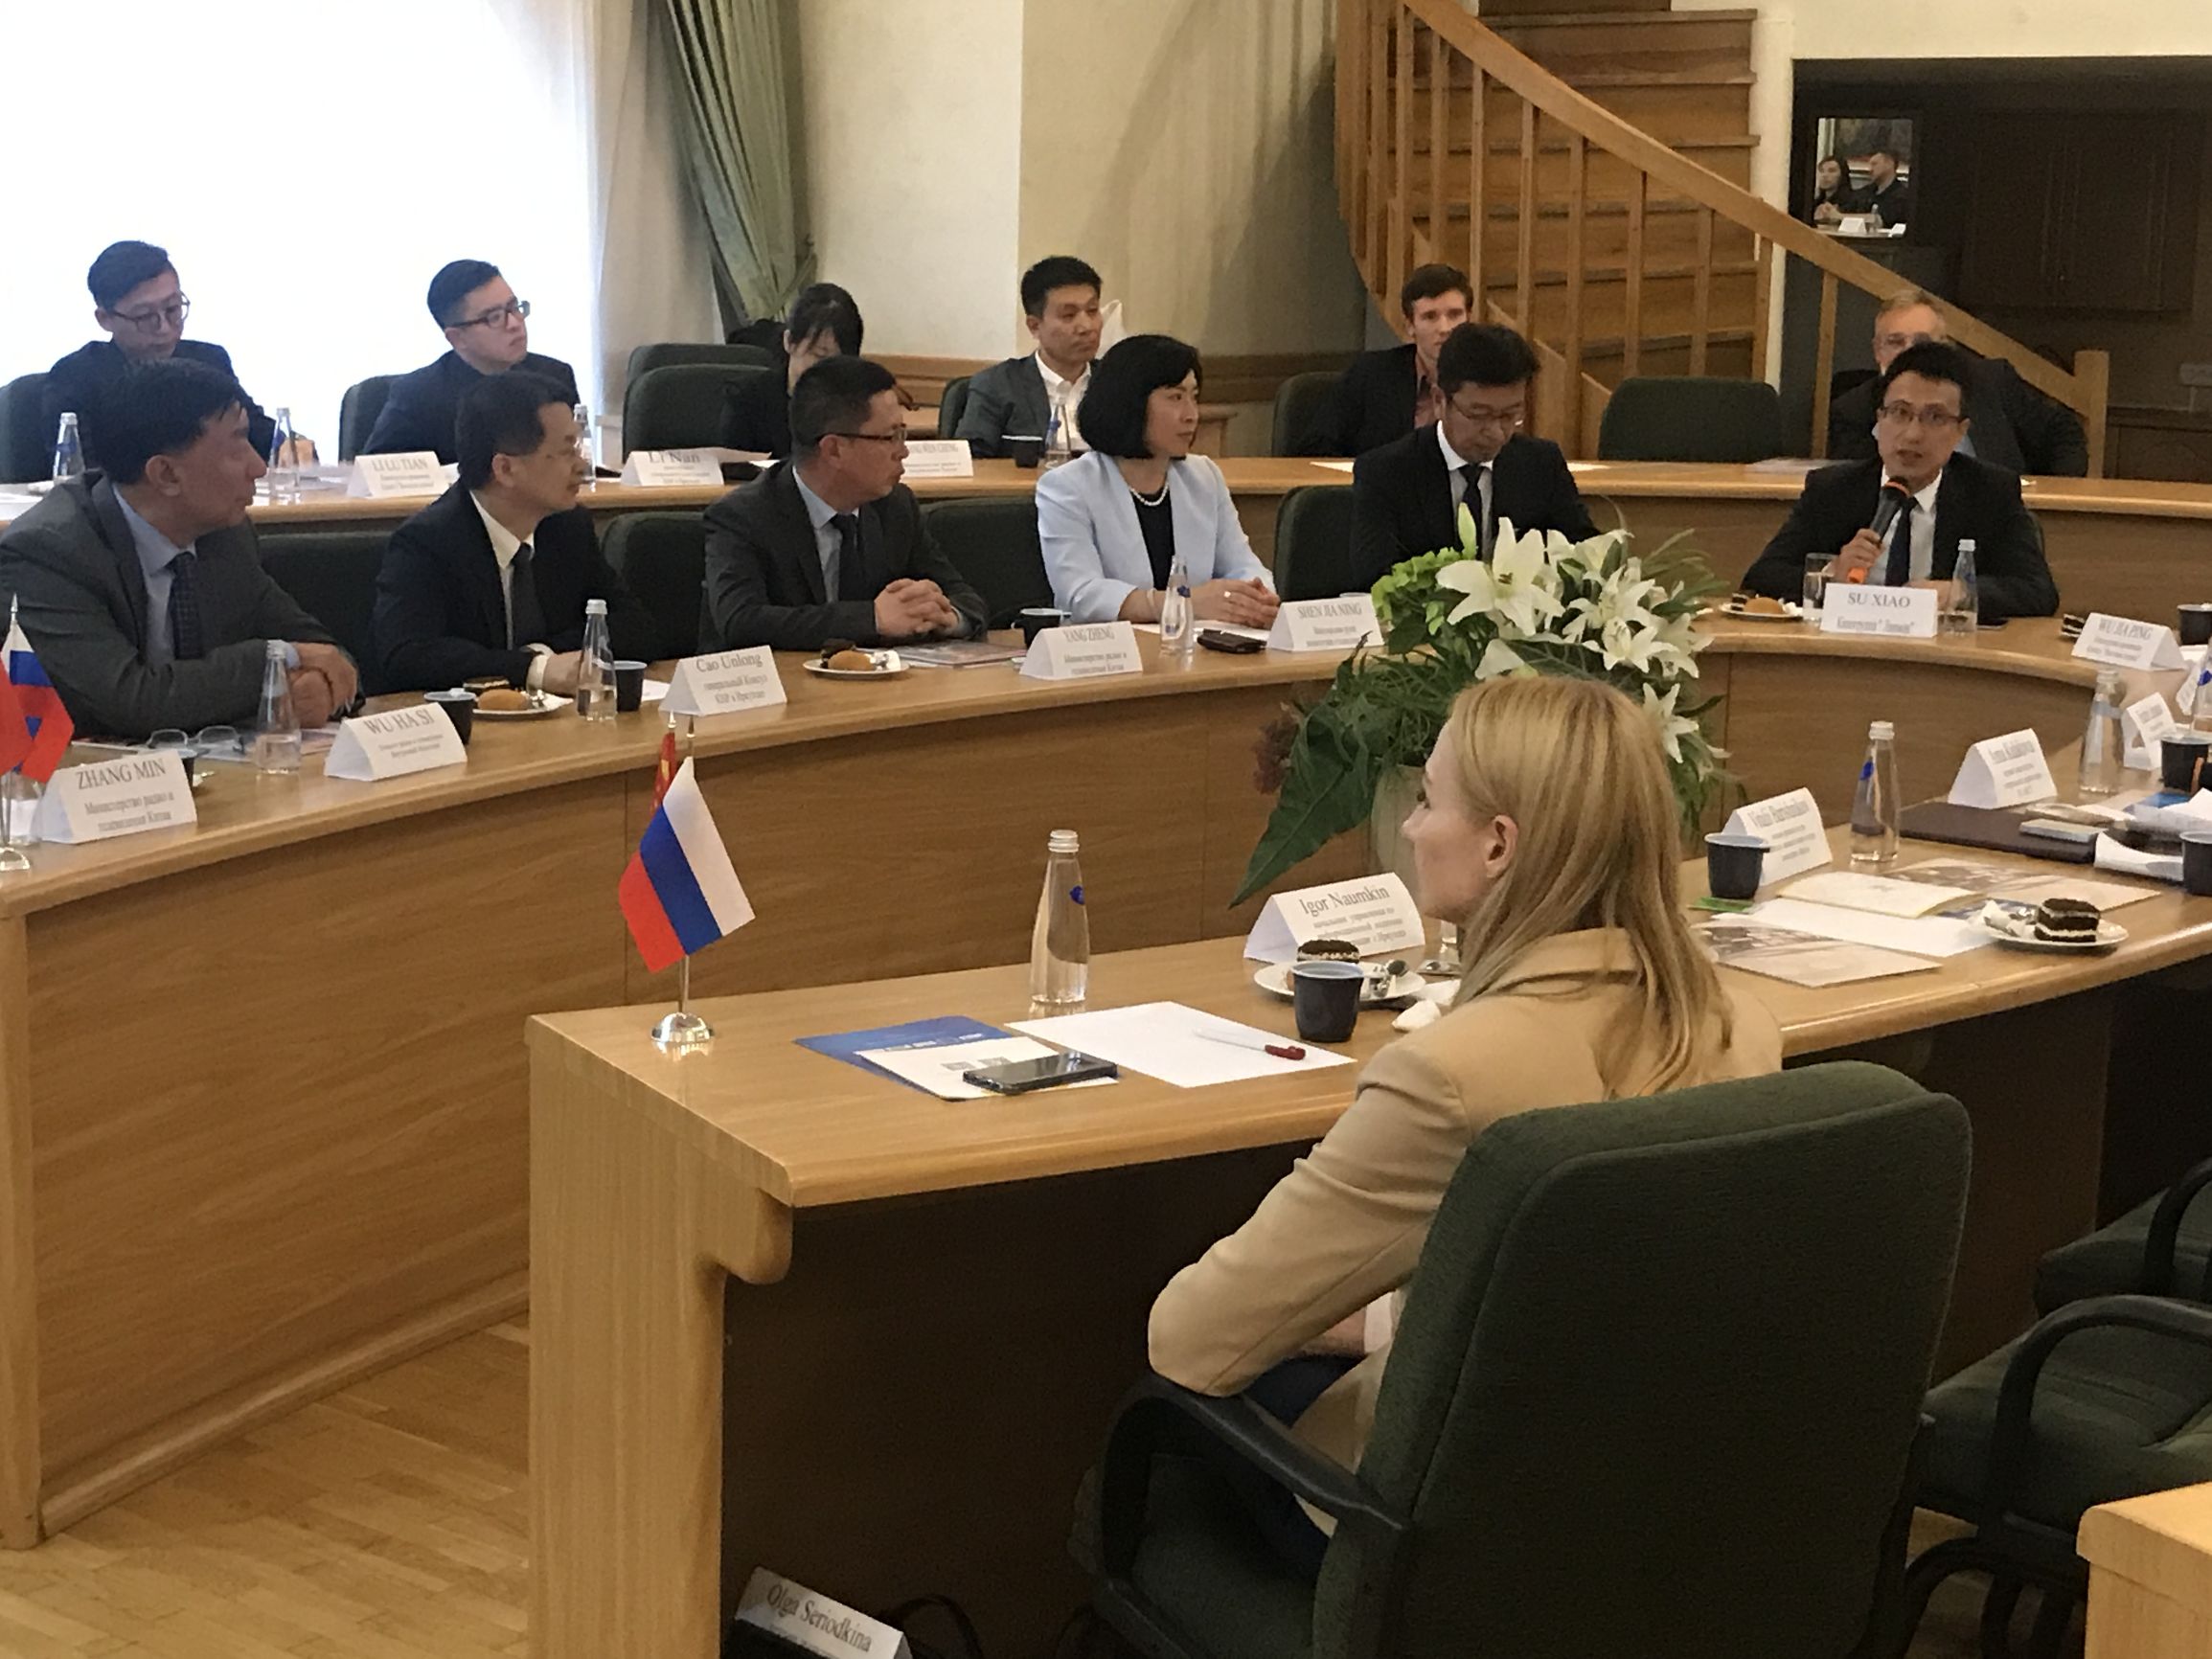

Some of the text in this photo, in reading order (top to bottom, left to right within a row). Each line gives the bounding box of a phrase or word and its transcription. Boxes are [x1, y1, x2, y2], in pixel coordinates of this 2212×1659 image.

[399, 458, 429, 470] TIAN
[1848, 592, 1911, 608] SU XIAO
[1296, 605, 1322, 619] SHEN
[1339, 602, 1362, 617] NING
[1062, 625, 1115, 643] YANG ZHENG
[696, 653, 764, 673] Cao Unlong
[362, 708, 436, 735] WU HA SI
[76, 758, 167, 790] ZHANG MIN
[1298, 884, 1390, 918] Igor Naumkin
[767, 1583, 800, 1618] Olga
[800, 1600, 873, 1652] Seriodkina
